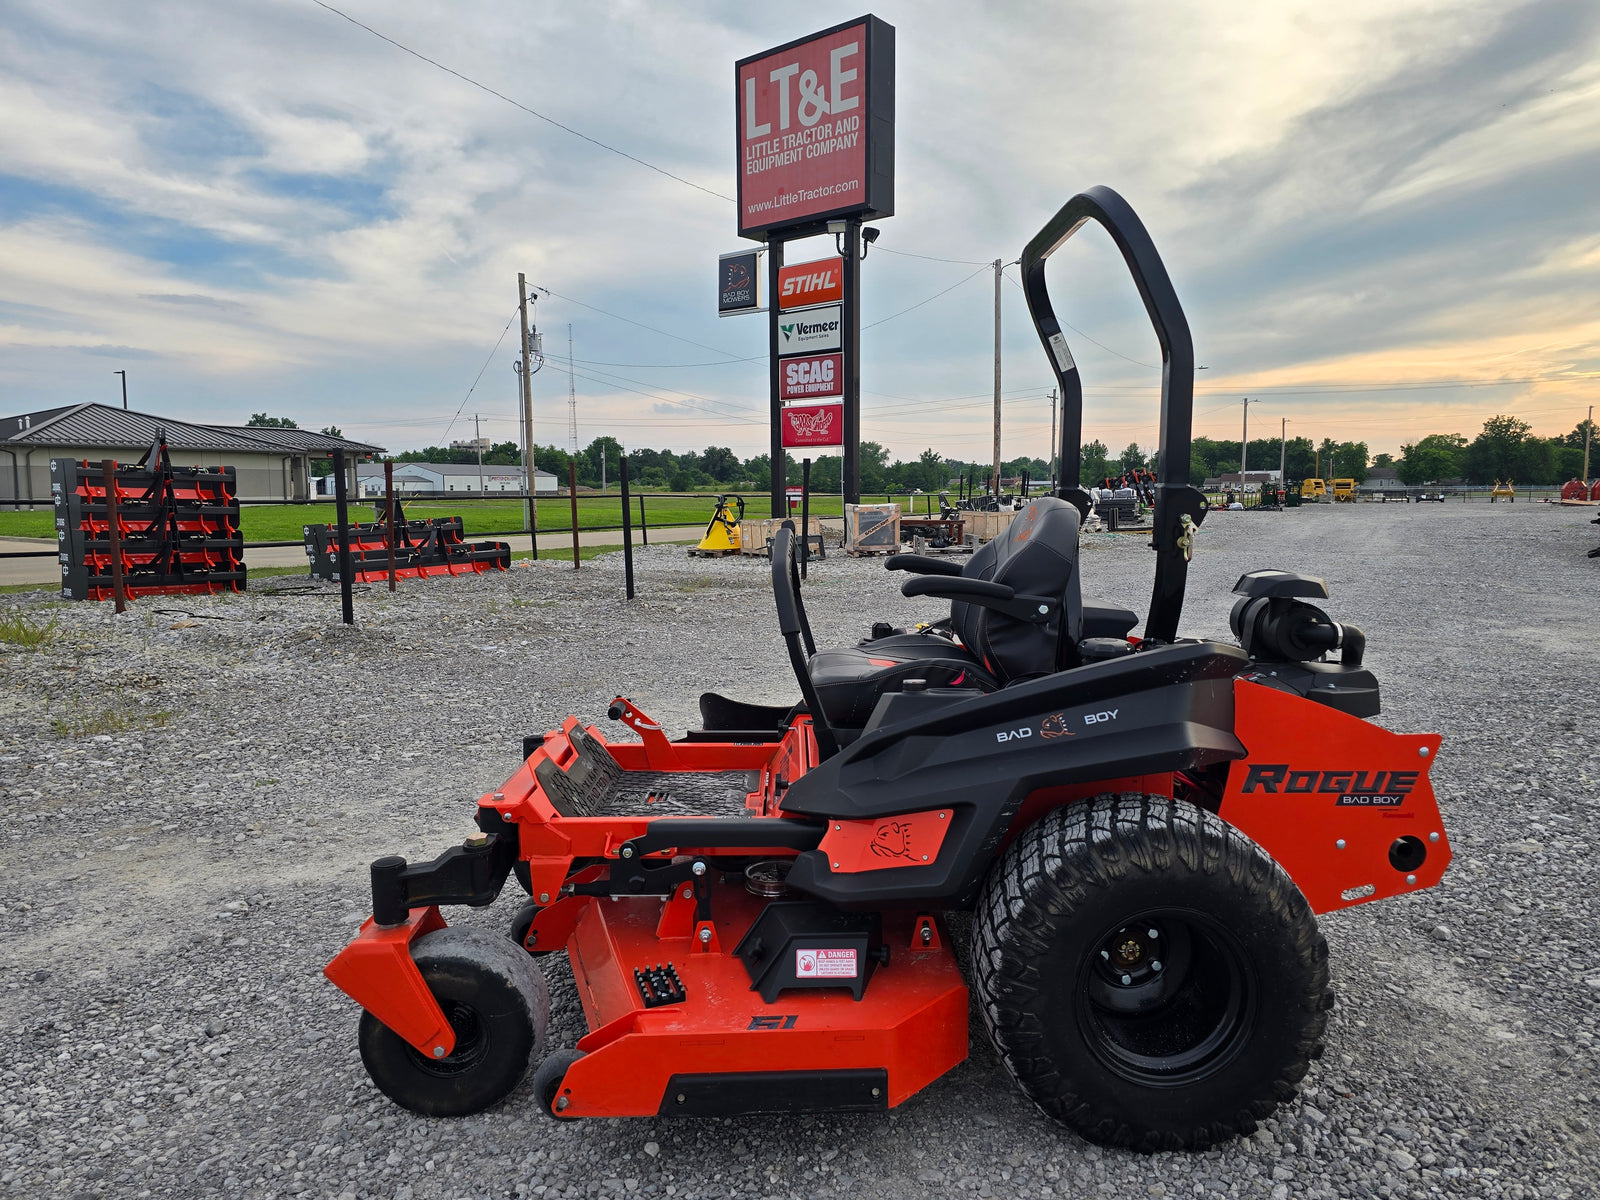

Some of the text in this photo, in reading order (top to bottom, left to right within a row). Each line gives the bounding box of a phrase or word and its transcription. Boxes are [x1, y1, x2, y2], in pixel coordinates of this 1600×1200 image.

[746, 41, 859, 140] LT&E
[746, 115, 860, 161] LITTLE TRACTOR AND
[746, 132, 859, 175] EQUIPMENT COMPANY
[747, 179, 859, 214] www.LittleTractor.com
[722, 289, 750, 299] BAD BOY
[782, 271, 836, 296] STIHL
[722, 295, 750, 304] MOWERS
[796, 320, 839, 335] Vermeer
[786, 359, 834, 385] SCAG
[786, 382, 834, 394] POWER EQUIPMENT
[996, 709, 1119, 742] BAD BOY
[1240, 764, 1420, 793] ROGUE
[1343, 796, 1400, 804] BAD BOY
[827, 951, 855, 959] DANGER
[746, 1015, 799, 1030] 61
